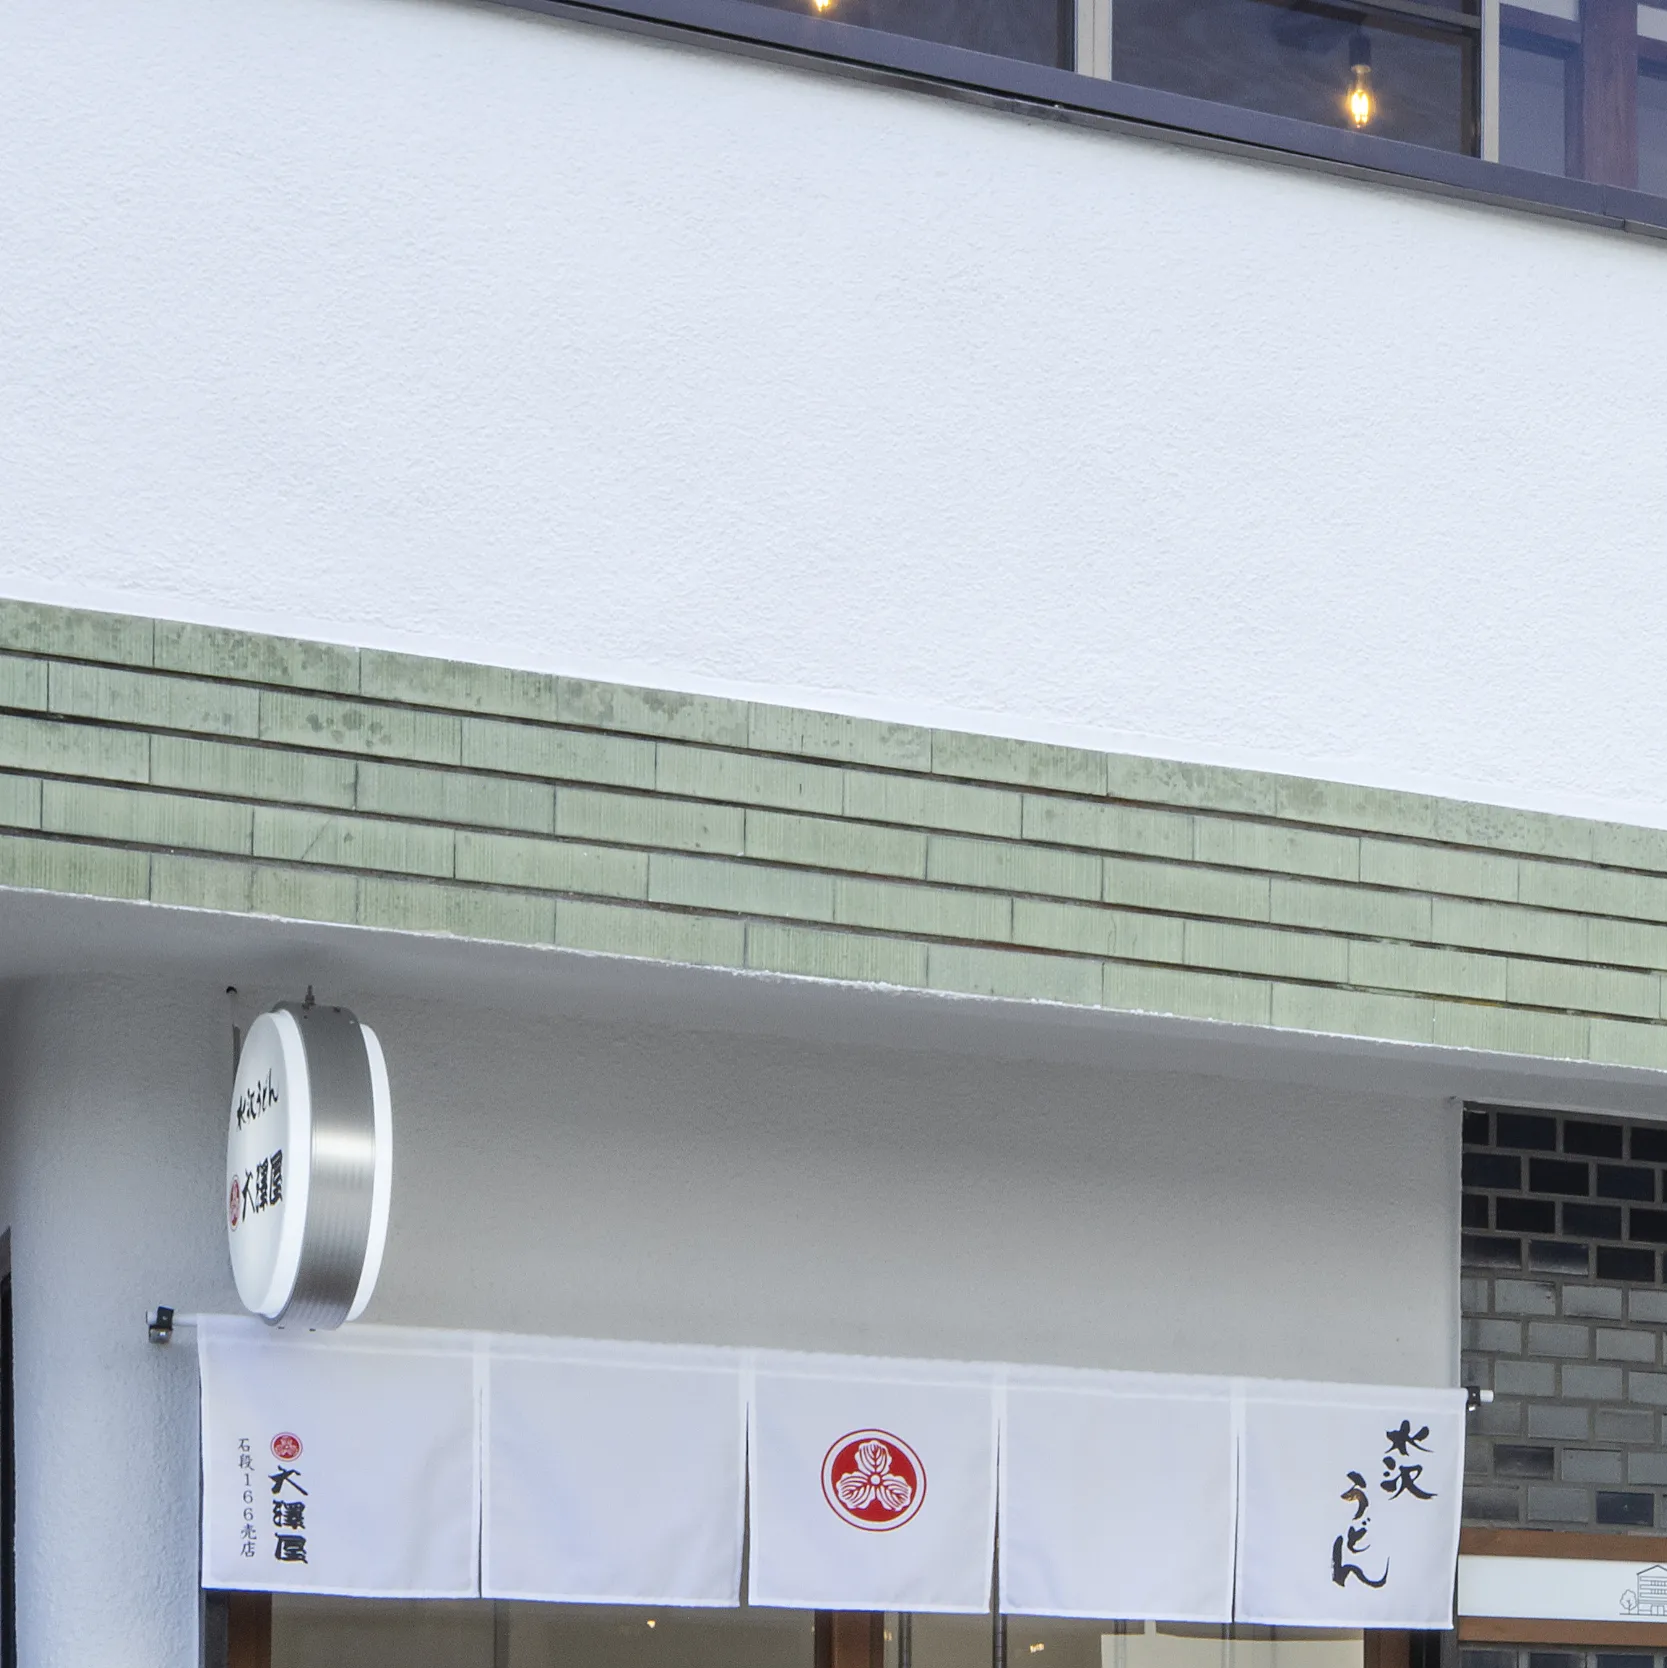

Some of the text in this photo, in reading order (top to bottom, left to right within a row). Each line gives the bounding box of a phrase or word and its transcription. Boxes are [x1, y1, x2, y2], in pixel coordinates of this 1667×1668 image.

[239, 1438, 257, 1557] 石段166売店
[1386, 1420, 1438, 1500] 水沢
[268, 1465, 308, 1564] 大澤屋
[1332, 1471, 1390, 1589] うどん
